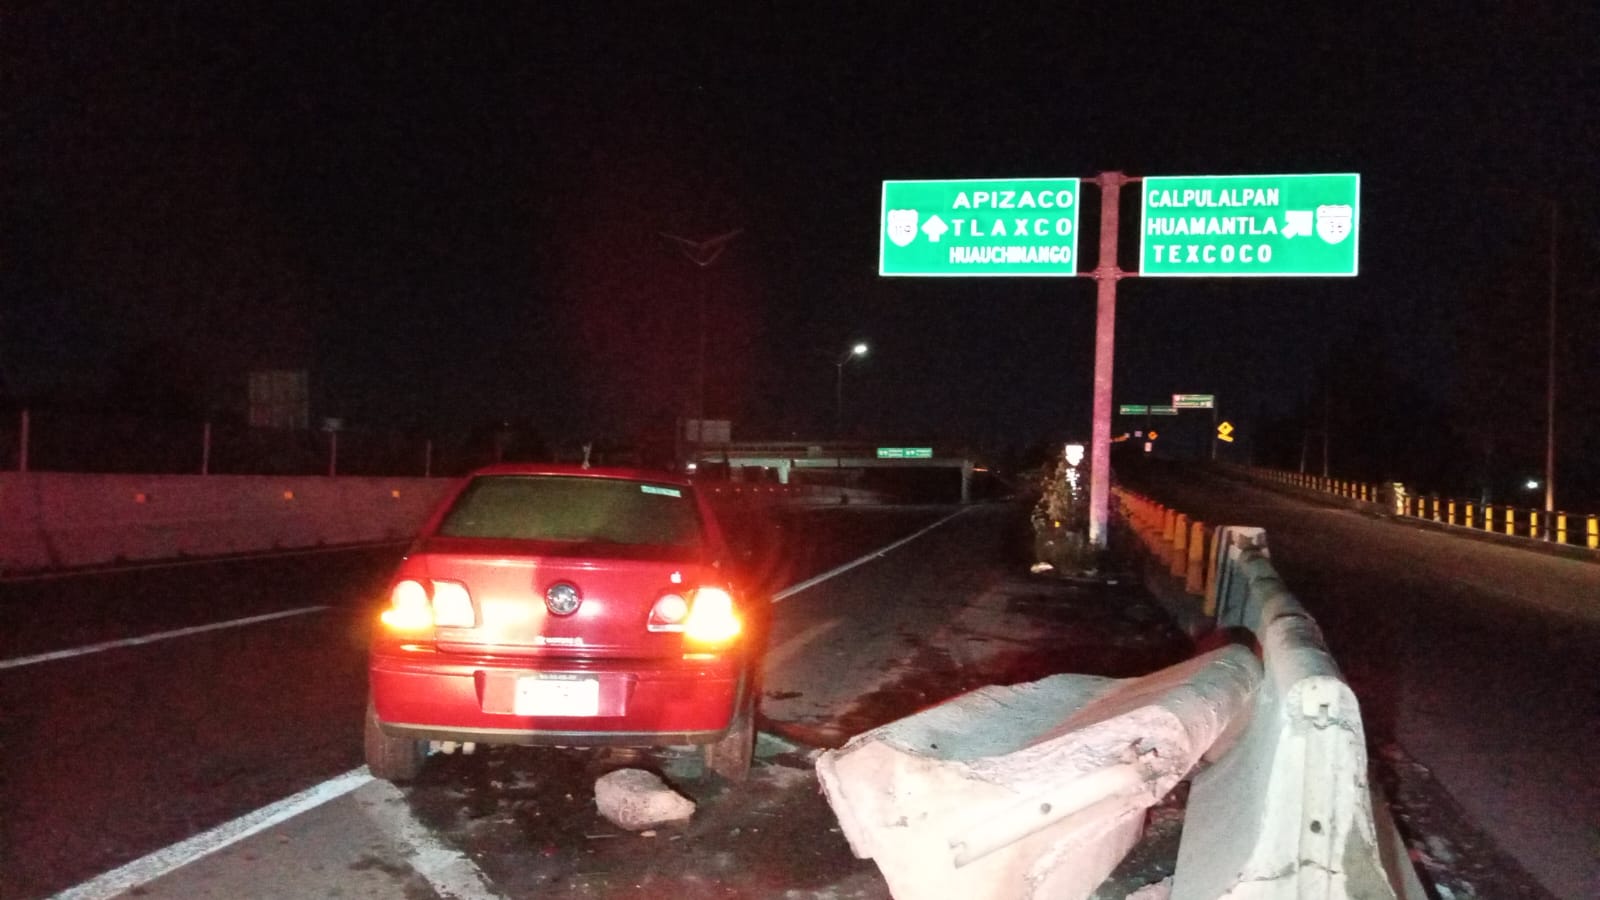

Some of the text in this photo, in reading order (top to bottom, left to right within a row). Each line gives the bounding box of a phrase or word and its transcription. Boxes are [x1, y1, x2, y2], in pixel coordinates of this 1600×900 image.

[952, 190, 1073, 209] APIZACO
[1148, 188, 1279, 207] CALPULALPAN
[951, 218, 1072, 237] TLAXCO
[1147, 217, 1278, 236] HUAMANTLA
[949, 246, 1071, 264] HUAUCHINANGO
[1153, 245, 1272, 263] TEXCOCO
